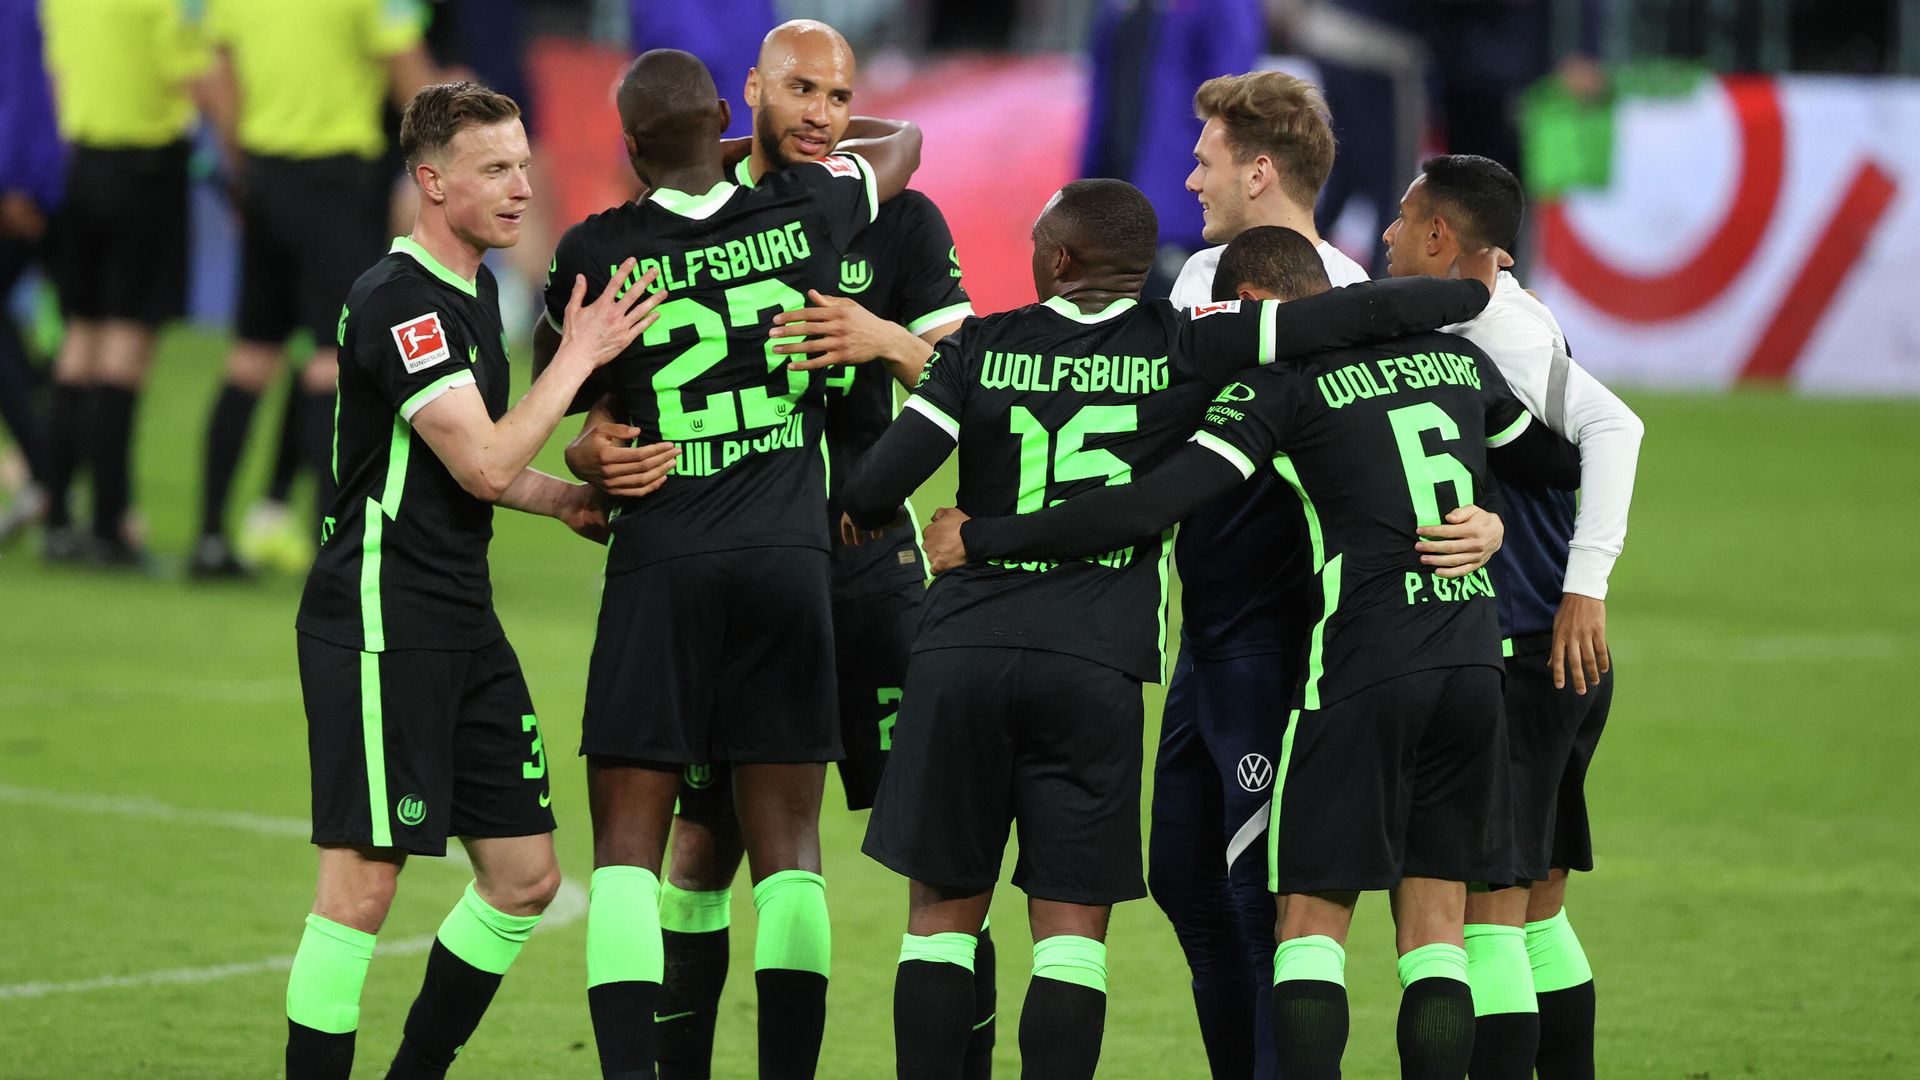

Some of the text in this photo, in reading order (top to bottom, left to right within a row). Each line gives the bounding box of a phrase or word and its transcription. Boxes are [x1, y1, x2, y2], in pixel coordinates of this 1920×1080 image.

[610, 221, 812, 300] WOLFSBURG
[642, 278, 810, 442] 23
[980, 350, 1170, 394] WOLFSBURG
[1317, 352, 1482, 409] WOLFSBURG
[1009, 404, 1138, 515] 15
[1387, 401, 1475, 542] 6
[1405, 571, 1429, 605] P.
